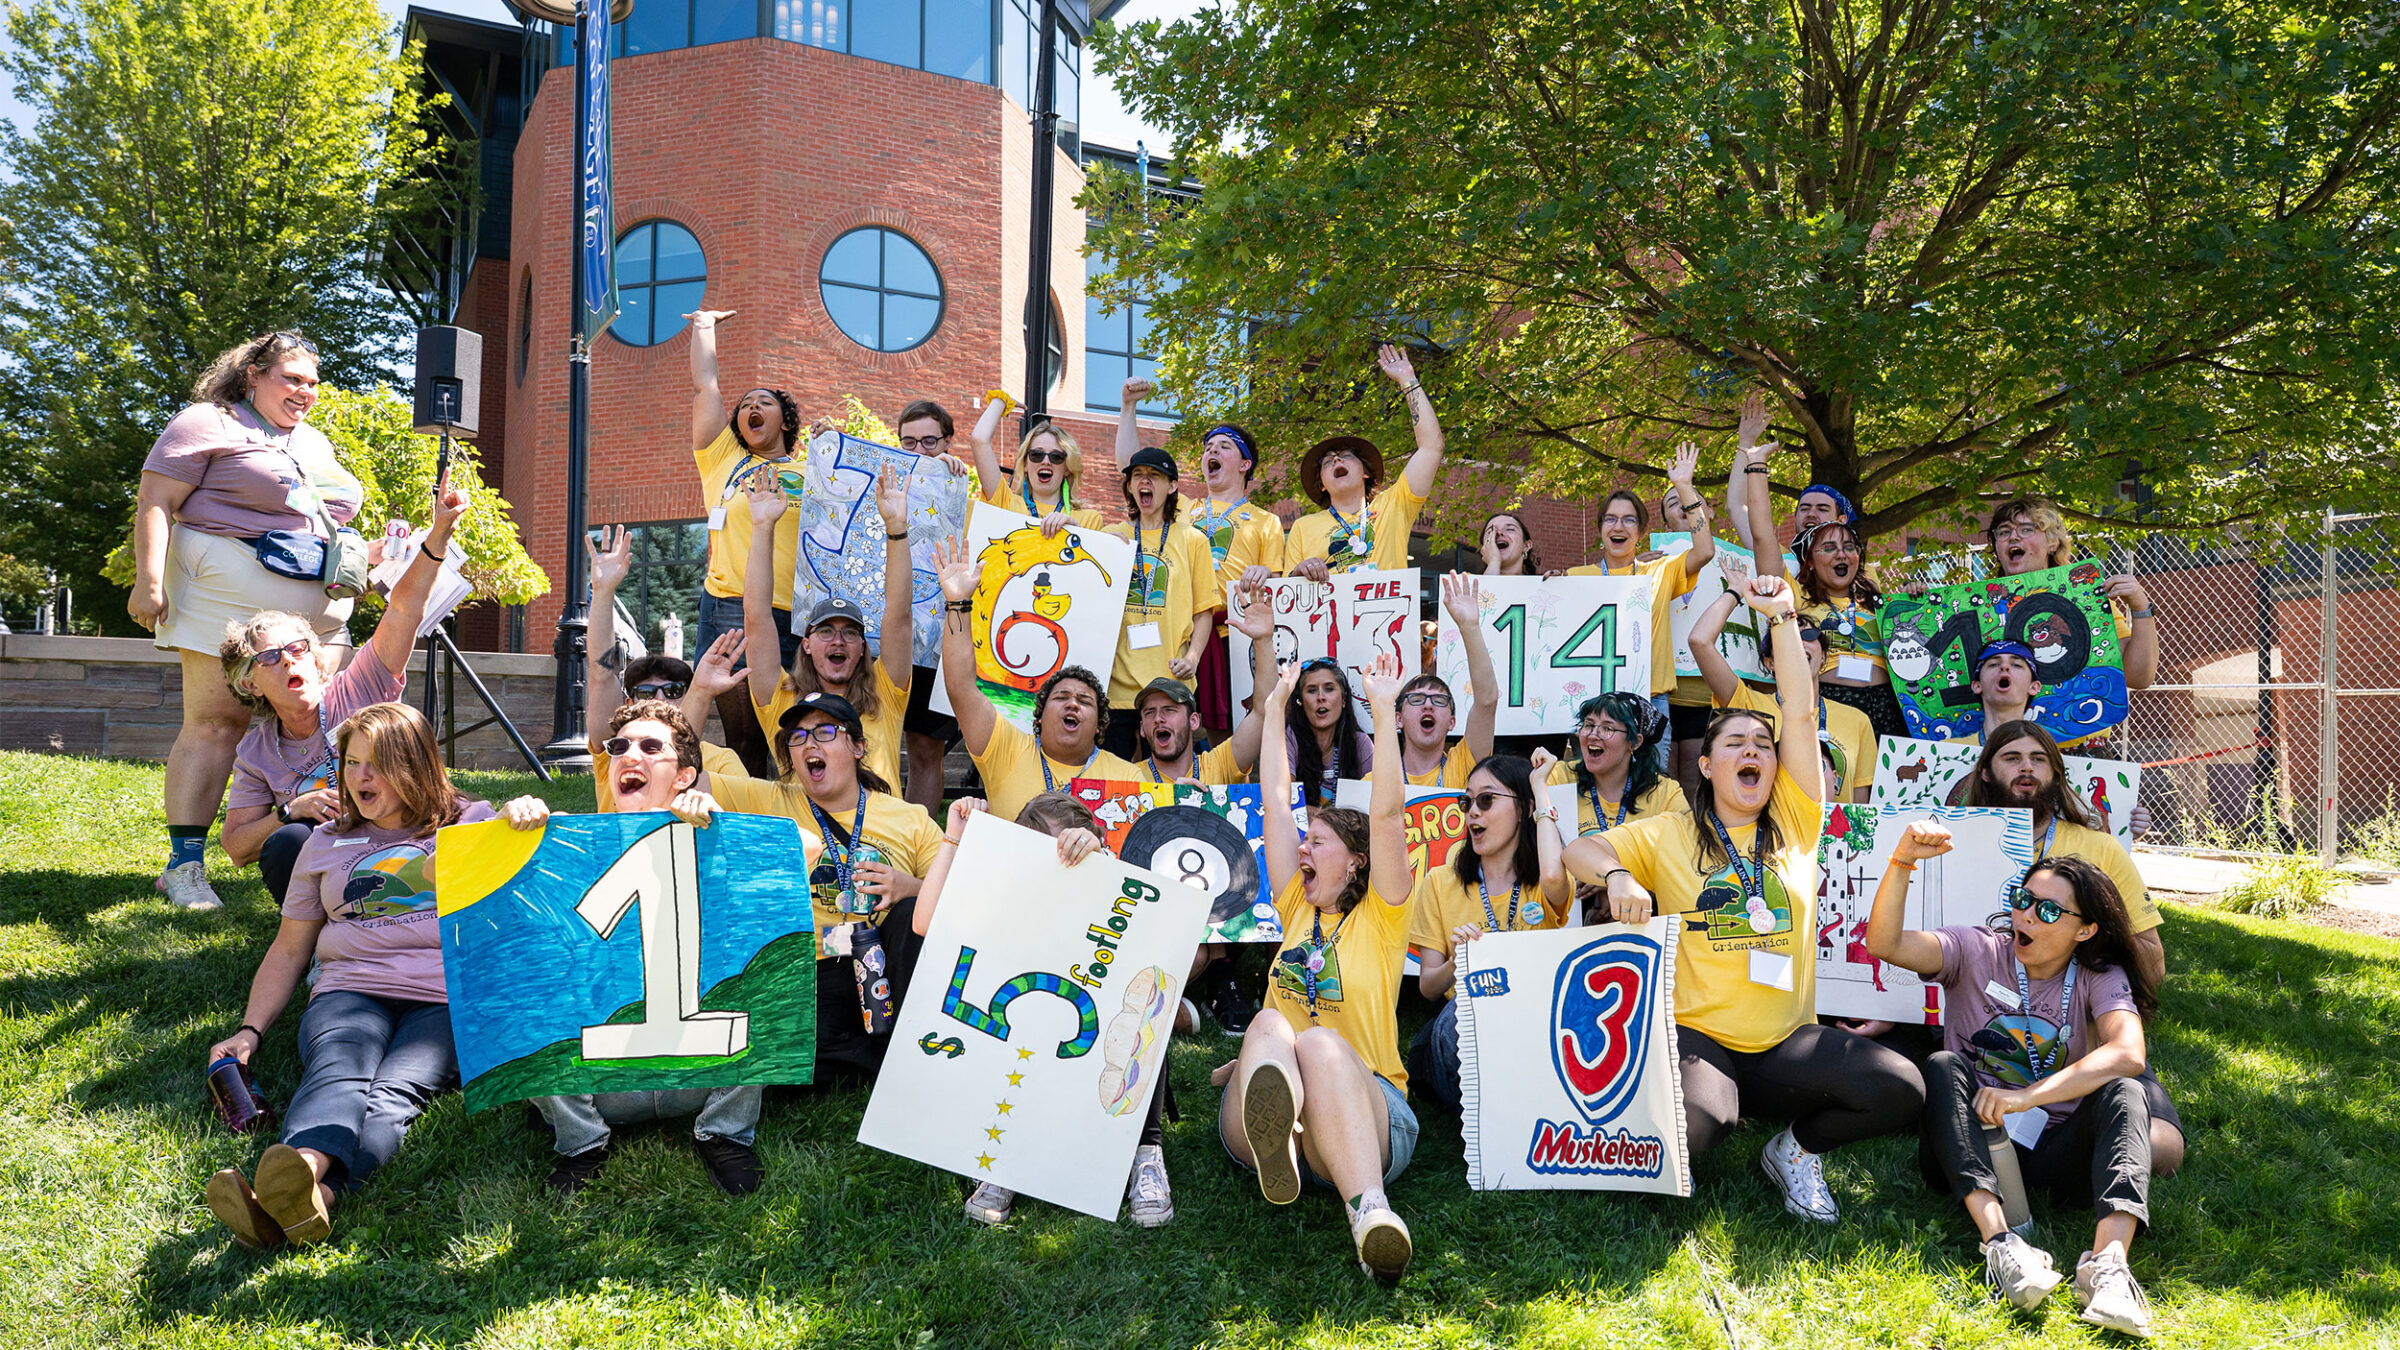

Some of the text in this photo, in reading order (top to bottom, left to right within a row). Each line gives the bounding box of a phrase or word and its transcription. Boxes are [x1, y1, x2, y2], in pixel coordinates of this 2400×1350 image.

[283, 551, 319, 564] COLLEGE
[1354, 581, 1401, 600] THE
[1493, 604, 1626, 707] 14
[1925, 592, 2091, 707] 10
[823, 826, 841, 863] CHAMPLAIN
[850, 825, 861, 853] COLLEGE
[1404, 802, 1466, 848] GRO
[1178, 848, 1209, 891] 8
[1712, 816, 1727, 840] COLLEGE
[1726, 843, 1748, 884] CHAMPLAIN
[574, 821, 750, 1061] 1
[1070, 876, 1160, 988] footlong
[1470, 969, 1502, 993] FUN
[1563, 966, 1640, 1097] 3
[1534, 1125, 1659, 1169] Musketeers
